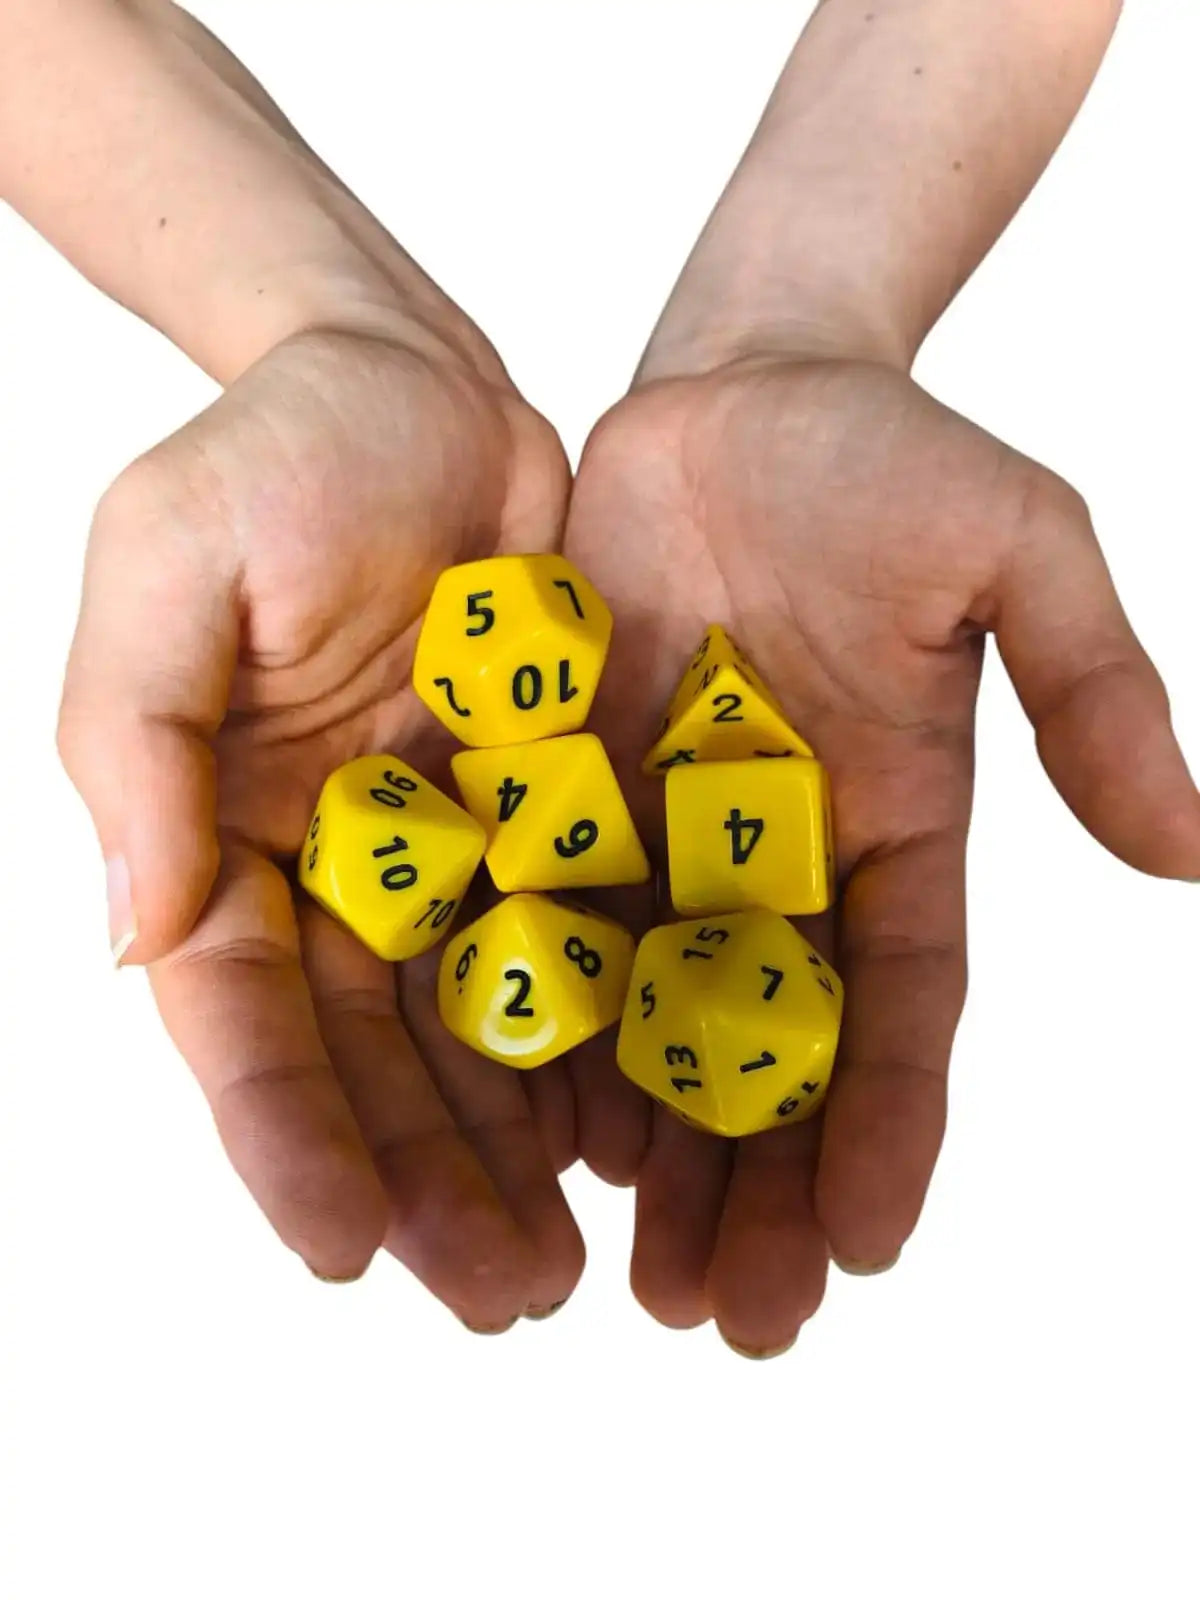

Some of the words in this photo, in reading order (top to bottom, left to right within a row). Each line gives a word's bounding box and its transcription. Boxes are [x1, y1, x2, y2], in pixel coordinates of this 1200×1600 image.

[466, 591, 495, 637] 5
[513, 660, 578, 710] 10
[712, 694, 744, 723] 2
[370, 769, 418, 809] 90
[495, 777, 528, 823] 4
[724, 809, 764, 865] 4
[373, 836, 418, 891] 10
[564, 936, 603, 980] 8
[682, 926, 730, 960] 15
[504, 968, 534, 1018] 2
[640, 981, 657, 1020] 5
[761, 965, 784, 1002] 7
[665, 1044, 703, 1093] 13
[740, 1050, 777, 1074] 1
